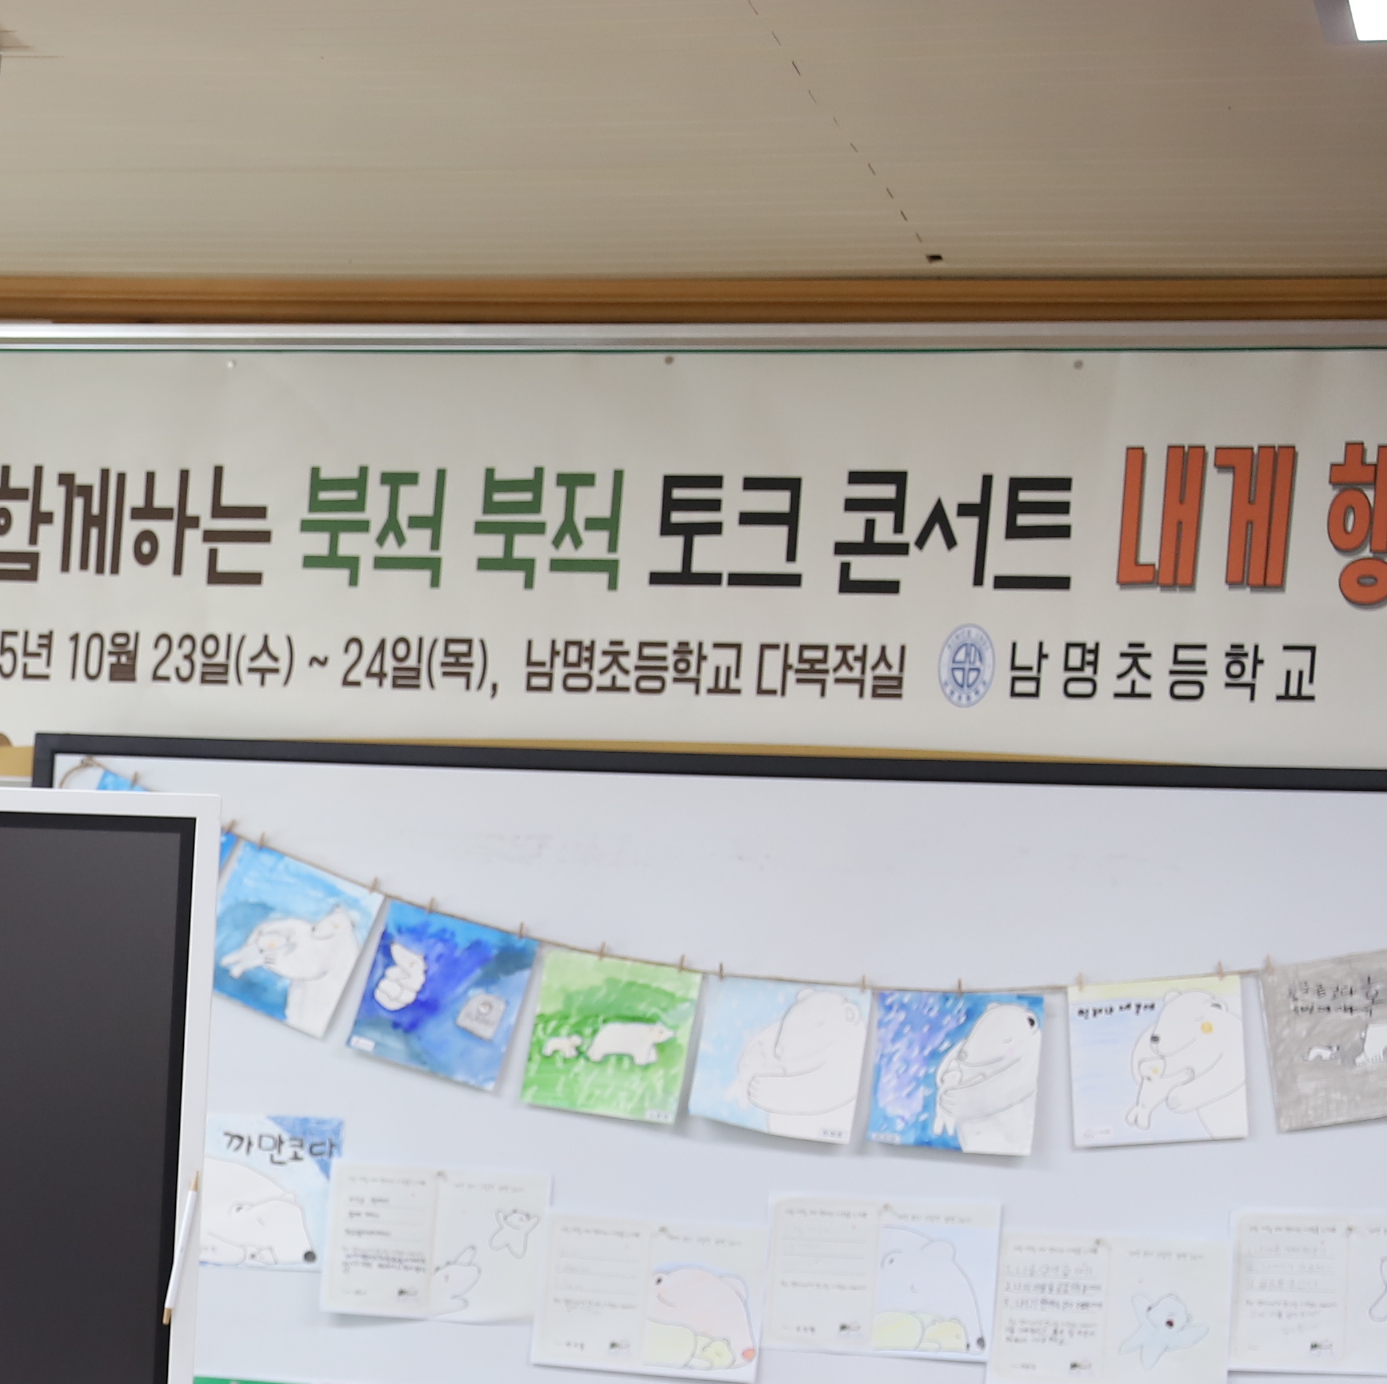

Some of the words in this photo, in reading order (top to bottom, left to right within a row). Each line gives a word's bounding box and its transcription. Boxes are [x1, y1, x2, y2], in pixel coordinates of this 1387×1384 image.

[299, 464, 448, 588] 북적
[473, 466, 625, 591] 북적
[648, 474, 803, 588] 토크
[833, 470, 1073, 595] 콘서트
[1116, 443, 1298, 594] 내게
[69, 631, 140, 683] 10월
[151, 632, 295, 687] 23일(수)
[341, 636, 500, 700] 24일(목),
[524, 638, 743, 697] 남명초등학교
[755, 642, 907, 700] 다목적실
[1009, 640, 1318, 703] 남명초등학교
